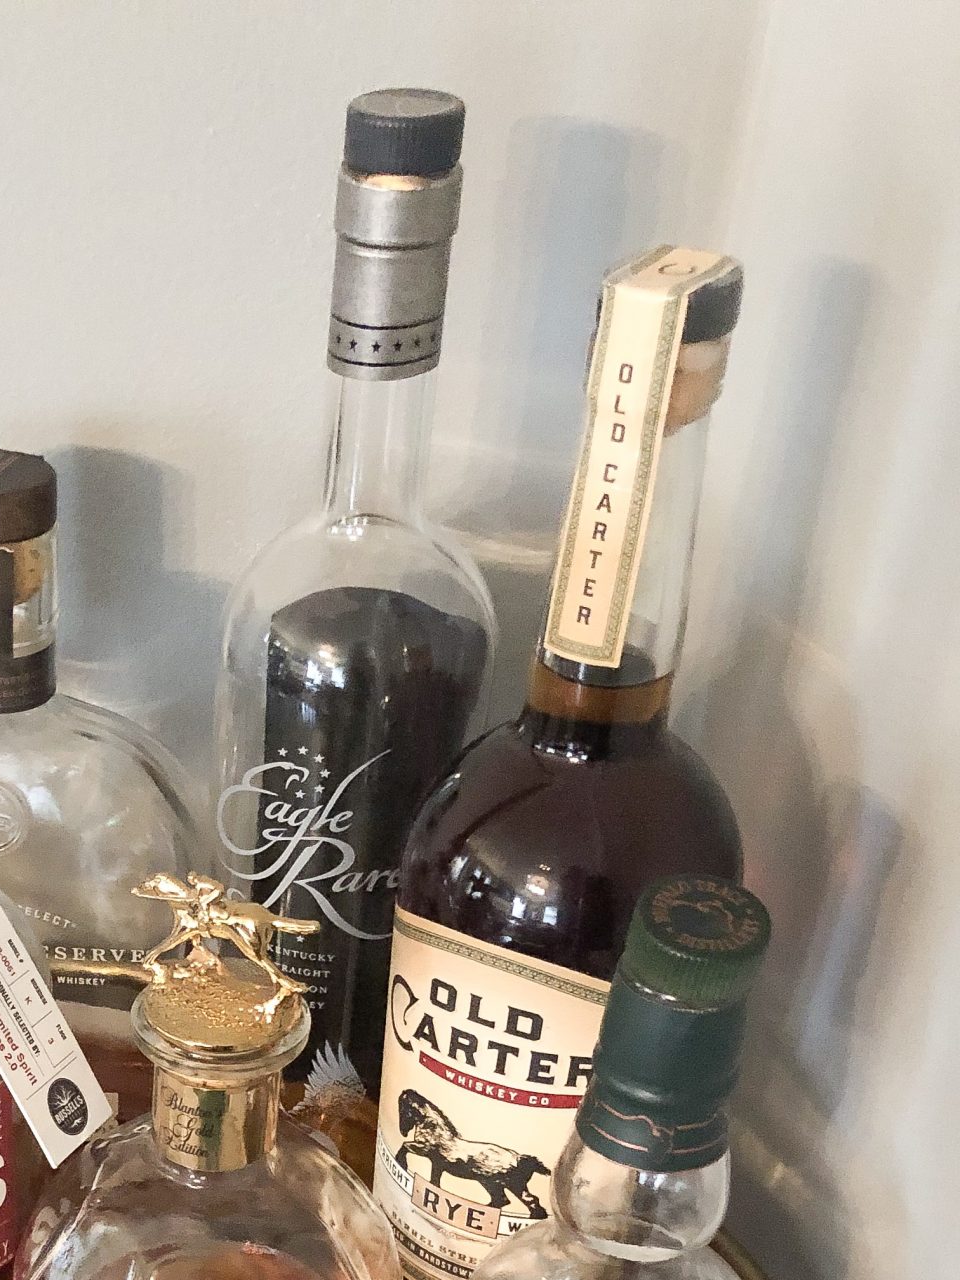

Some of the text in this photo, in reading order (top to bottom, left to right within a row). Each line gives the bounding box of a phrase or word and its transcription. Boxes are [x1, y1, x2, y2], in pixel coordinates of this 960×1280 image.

[610, 362, 634, 444] OLD
[576, 463, 619, 626] CARTER
[217, 750, 391, 880] Eagle
[18, 904, 71, 929] ELECT
[42, 945, 145, 963] SERVE
[267, 944, 336, 962] KENTUCKY
[56, 976, 106, 986] WHISKEY
[430, 978, 544, 1042] OLD
[13, 1011, 35, 1046] SELECTED
[391, 974, 593, 1088] CARTER
[4, 1052, 18, 1071] 2.0
[17, 1052, 38, 1086] Spirit
[444, 1070, 550, 1106] WHISKEY CO
[423, 1187, 486, 1231] RYE
[439, 1245, 478, 1265] STRE
